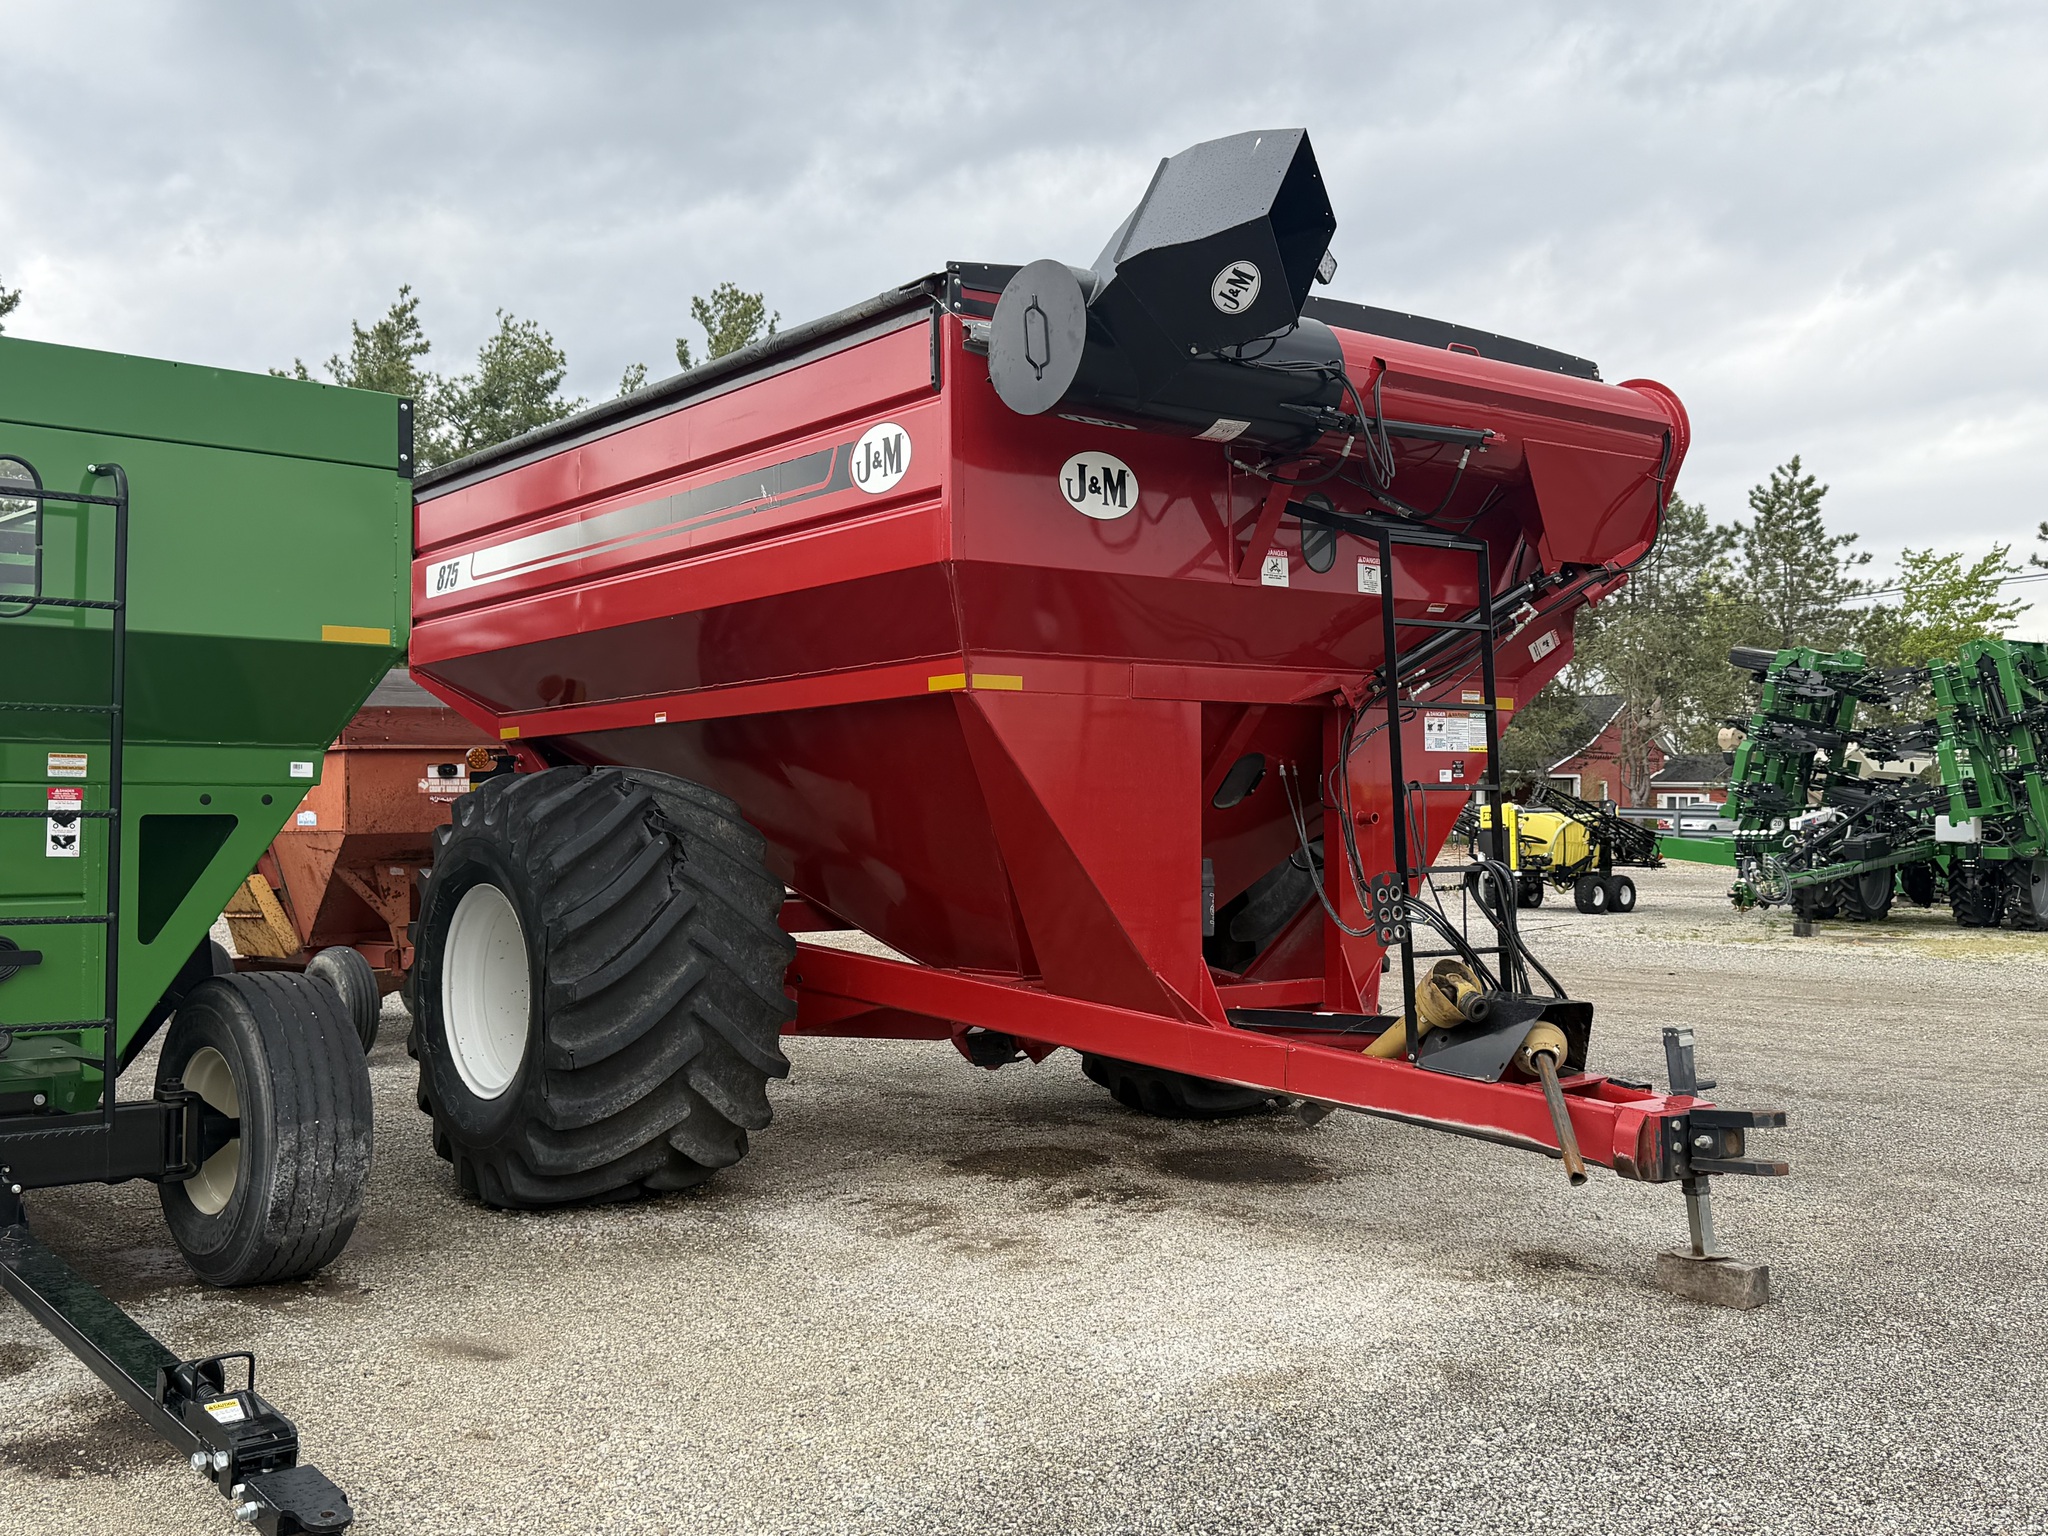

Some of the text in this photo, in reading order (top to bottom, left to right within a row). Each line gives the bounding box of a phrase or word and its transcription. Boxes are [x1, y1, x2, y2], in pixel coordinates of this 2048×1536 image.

[1218, 267, 1256, 310] J&M
[856, 433, 903, 484] J&M
[1065, 463, 1128, 508] J&M
[437, 562, 460, 591] 875
